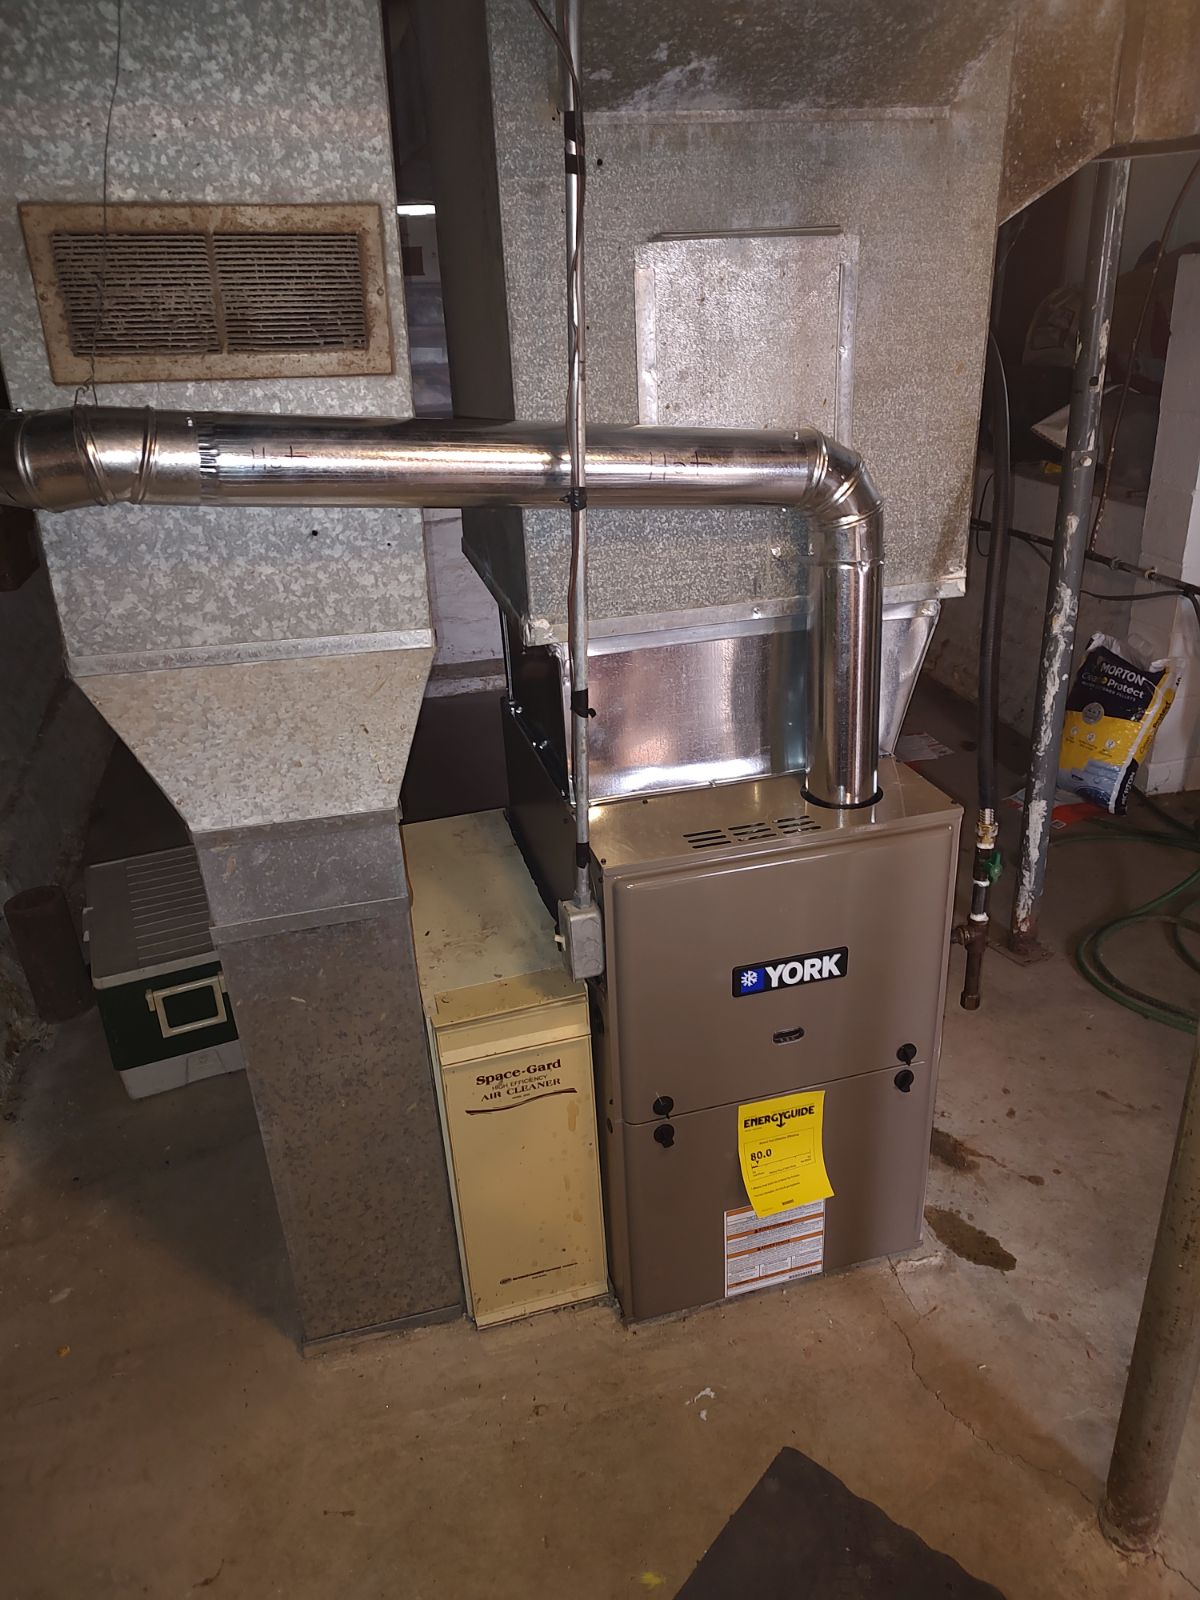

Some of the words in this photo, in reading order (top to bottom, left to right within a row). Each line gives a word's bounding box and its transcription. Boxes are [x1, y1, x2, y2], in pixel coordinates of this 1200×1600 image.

[1100, 662, 1144, 686] MORTON
[1107, 679, 1145, 699] Protect
[765, 953, 842, 988] YORK
[476, 1058, 562, 1086] Space-Gard
[491, 1082, 509, 1091] HIGH
[510, 1074, 548, 1087] EFFICIENCY
[481, 1091, 502, 1102] AIR
[506, 1078, 561, 1096] CLEANER
[743, 1105, 815, 1128] ENERGYGUIDE
[750, 1148, 772, 1161] 80.0
